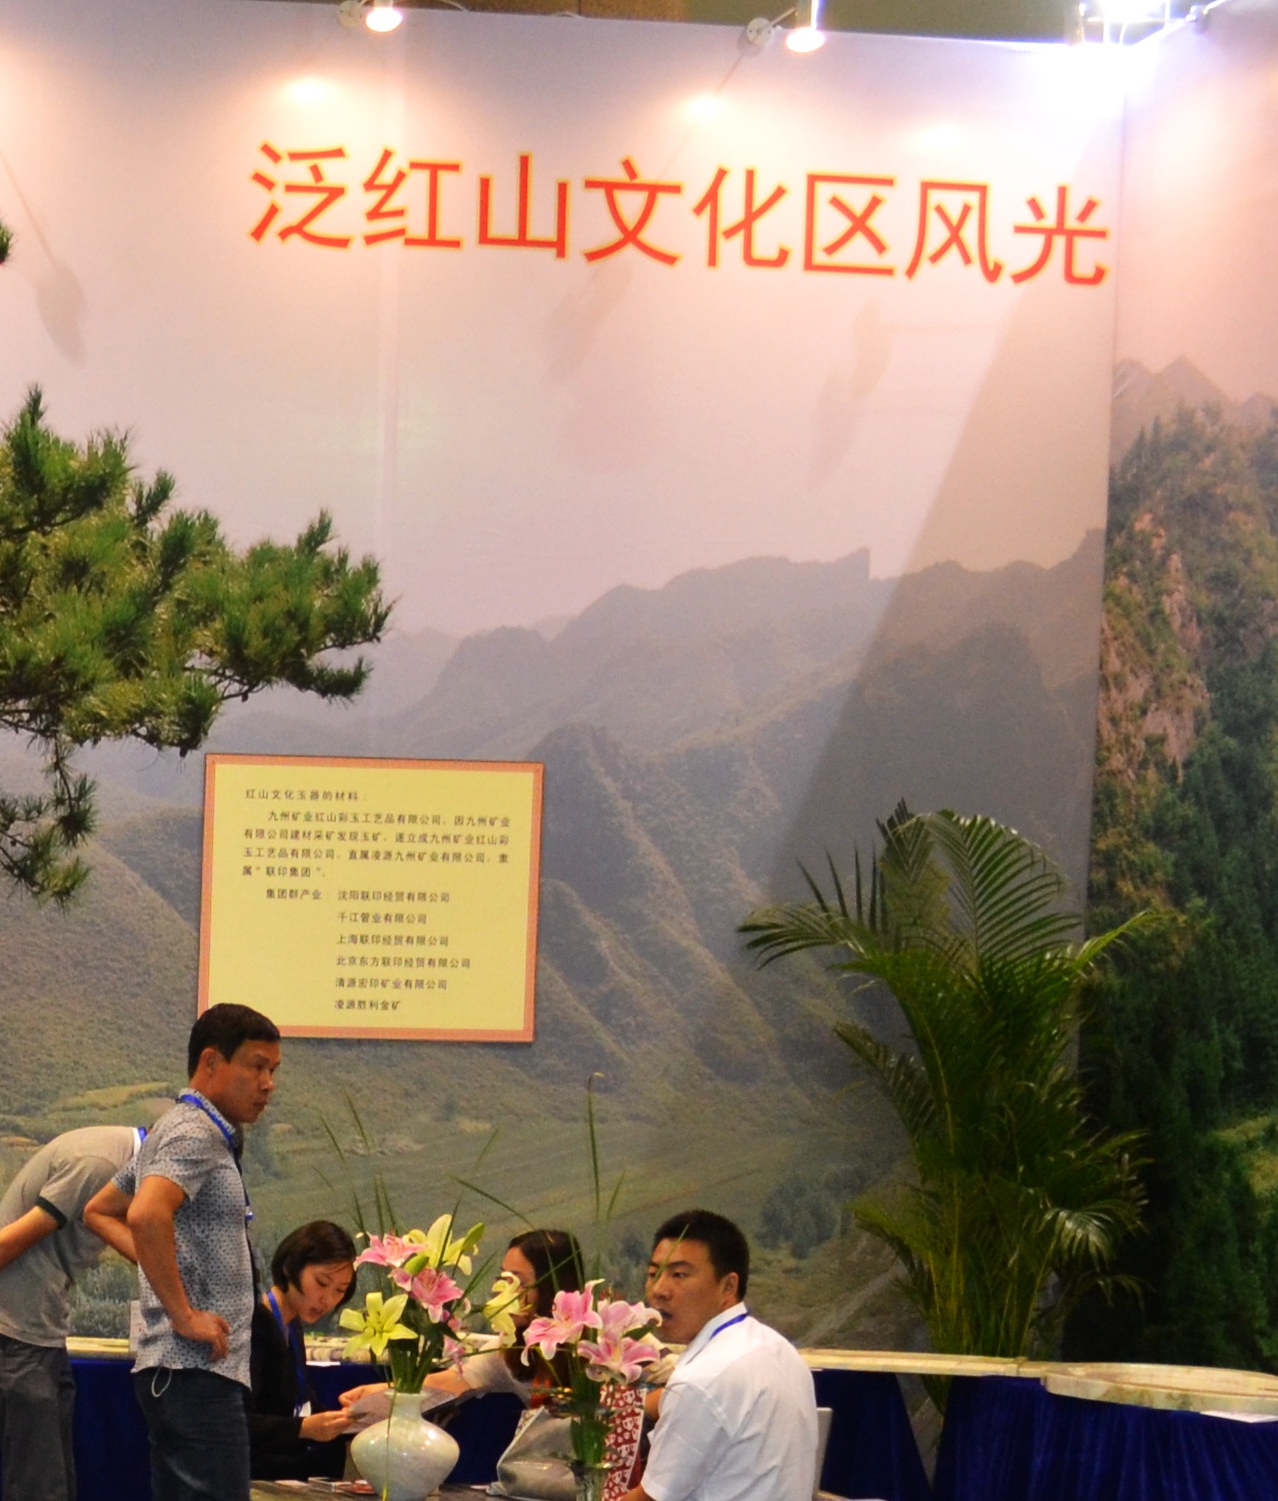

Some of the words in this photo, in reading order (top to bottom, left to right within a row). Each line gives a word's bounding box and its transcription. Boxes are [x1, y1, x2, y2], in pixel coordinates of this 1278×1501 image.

[248, 141, 1110, 288] 泛红山文化区风光
[336, 933, 450, 948] 上海联印经贸有限公司
[335, 954, 472, 970] 北京东方联印经贸有限公司
